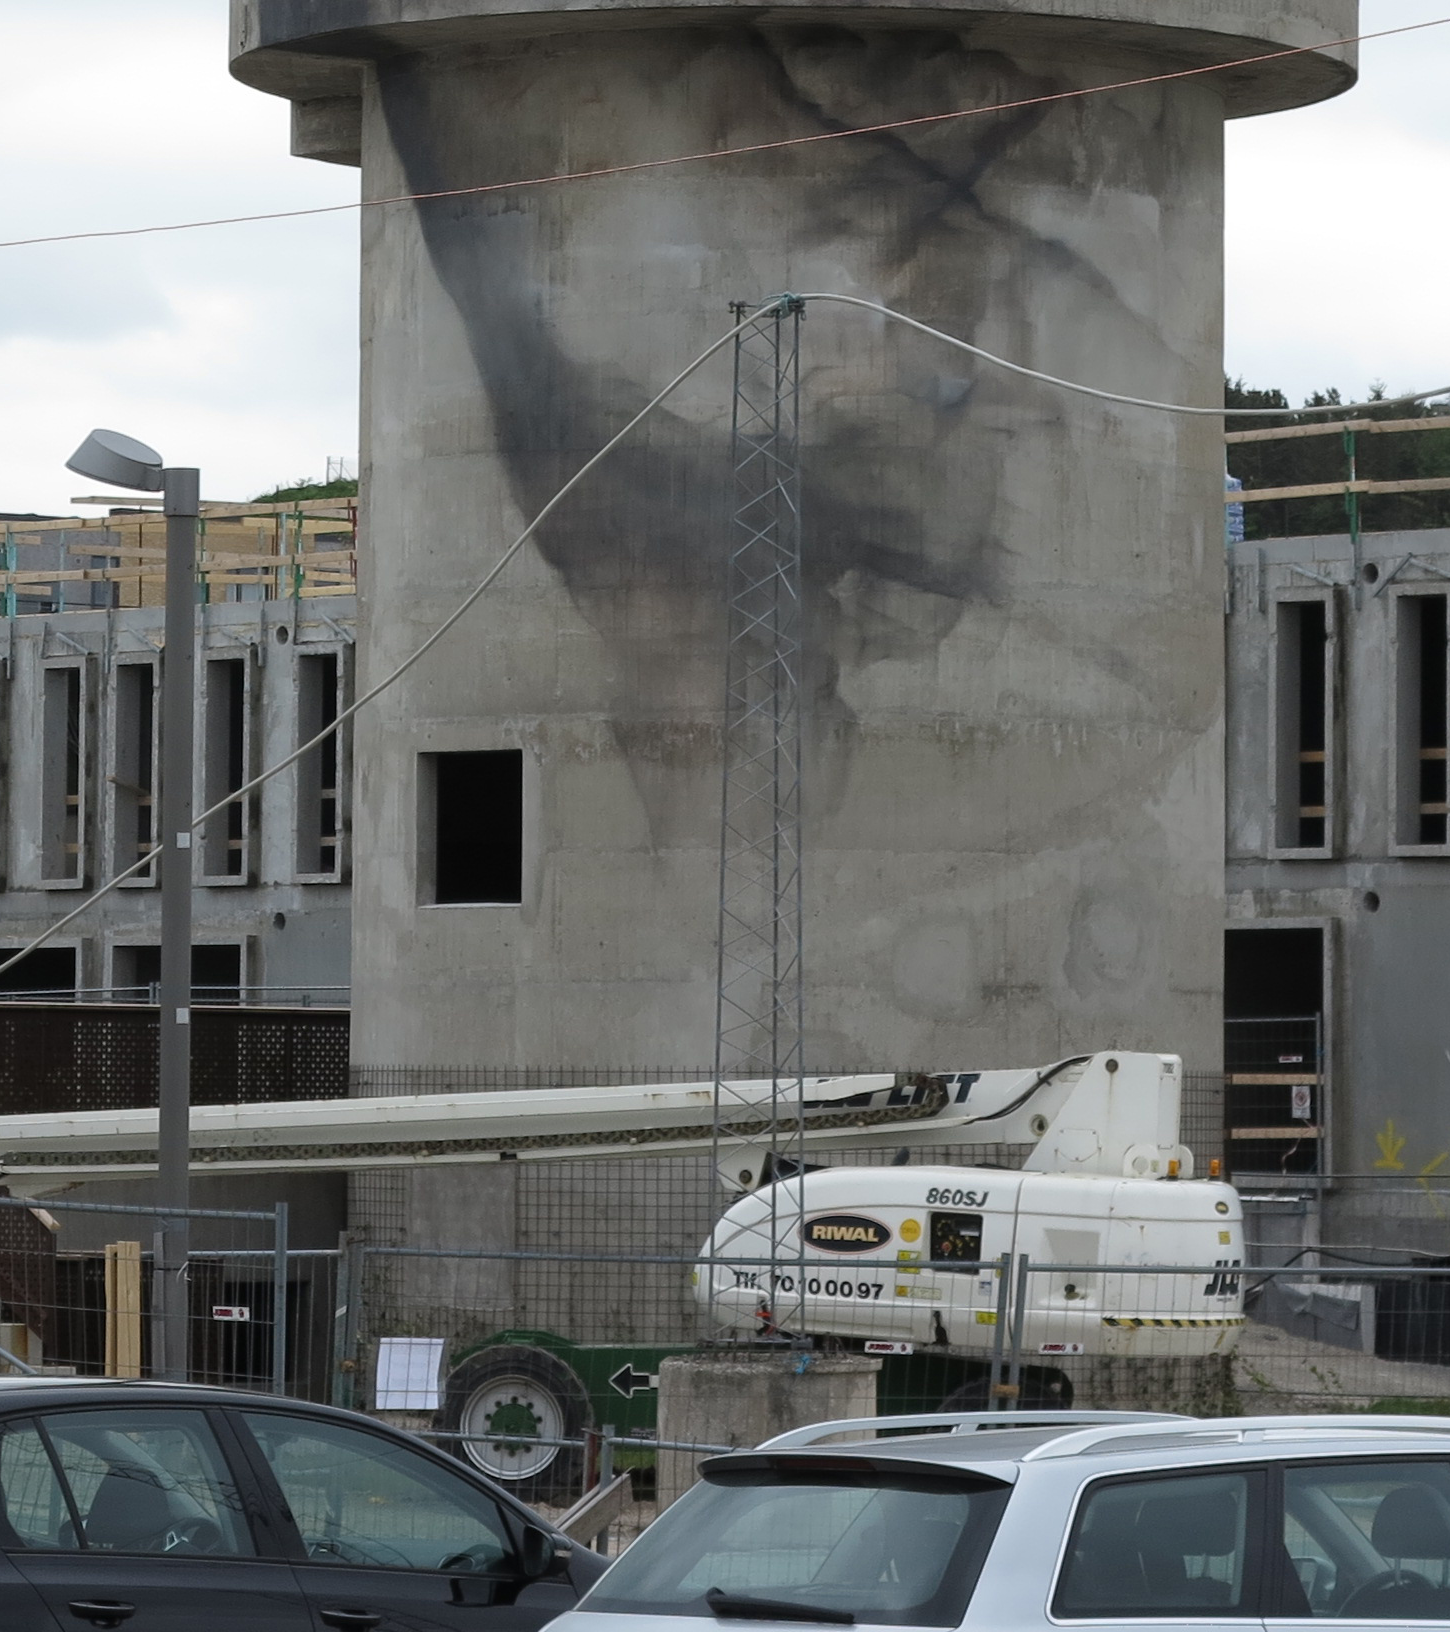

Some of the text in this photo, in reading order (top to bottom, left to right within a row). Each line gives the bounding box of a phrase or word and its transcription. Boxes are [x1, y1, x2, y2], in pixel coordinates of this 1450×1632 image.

[925, 1187, 990, 1208] 860SJ
[811, 1225, 879, 1243] RIWAL
[824, 1279, 853, 1298] 00
[856, 1282, 884, 1300] 97
